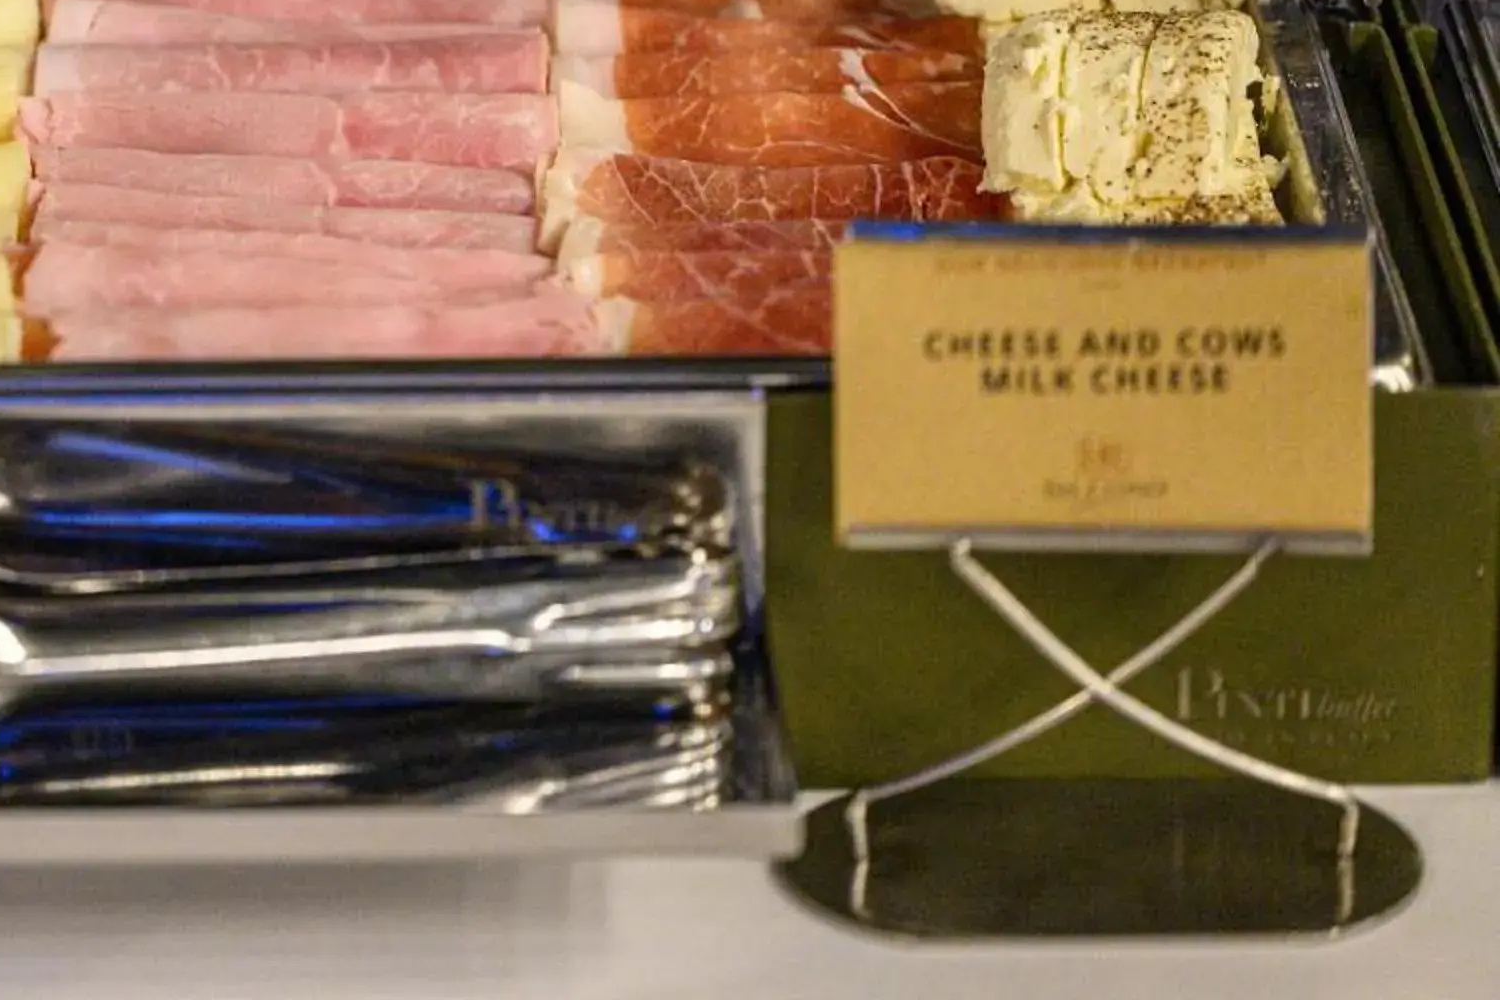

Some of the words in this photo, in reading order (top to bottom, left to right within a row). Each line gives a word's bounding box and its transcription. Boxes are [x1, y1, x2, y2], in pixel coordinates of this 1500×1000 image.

[922, 327, 1060, 360] CHEESE
[1078, 327, 1161, 358] AND
[1176, 325, 1286, 357] COWS
[980, 364, 1074, 394] MILK
[1090, 364, 1230, 393] CHEESE
